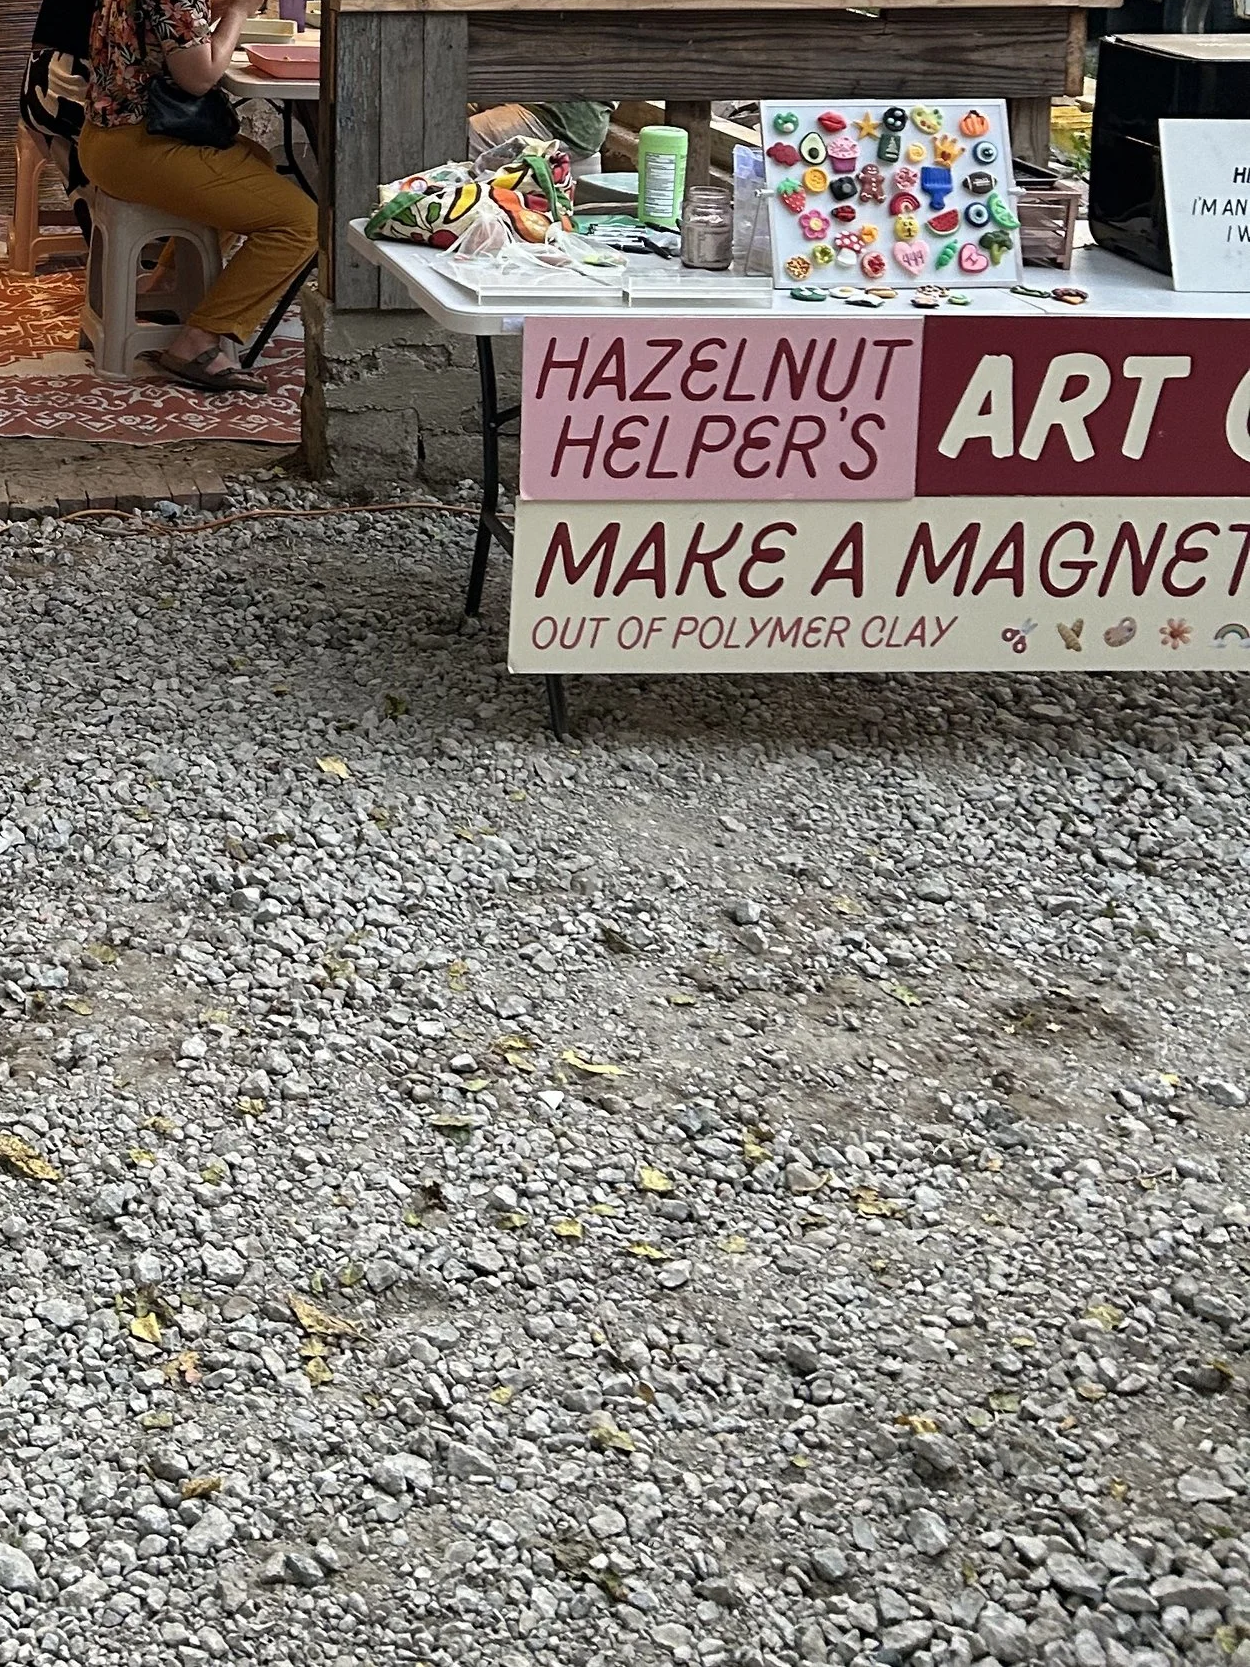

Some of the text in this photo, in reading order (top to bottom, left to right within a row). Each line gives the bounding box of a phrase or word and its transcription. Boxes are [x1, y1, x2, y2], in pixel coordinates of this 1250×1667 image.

[1192, 196, 1248, 216] I'M AN
[535, 337, 914, 403] HAZELNUT
[938, 353, 1192, 462] ART
[551, 407, 886, 481] HELPER'S
[535, 522, 797, 599] MAKE
[811, 522, 864, 599] A
[531, 615, 959, 651] OUT OF POLYMER CLAY
